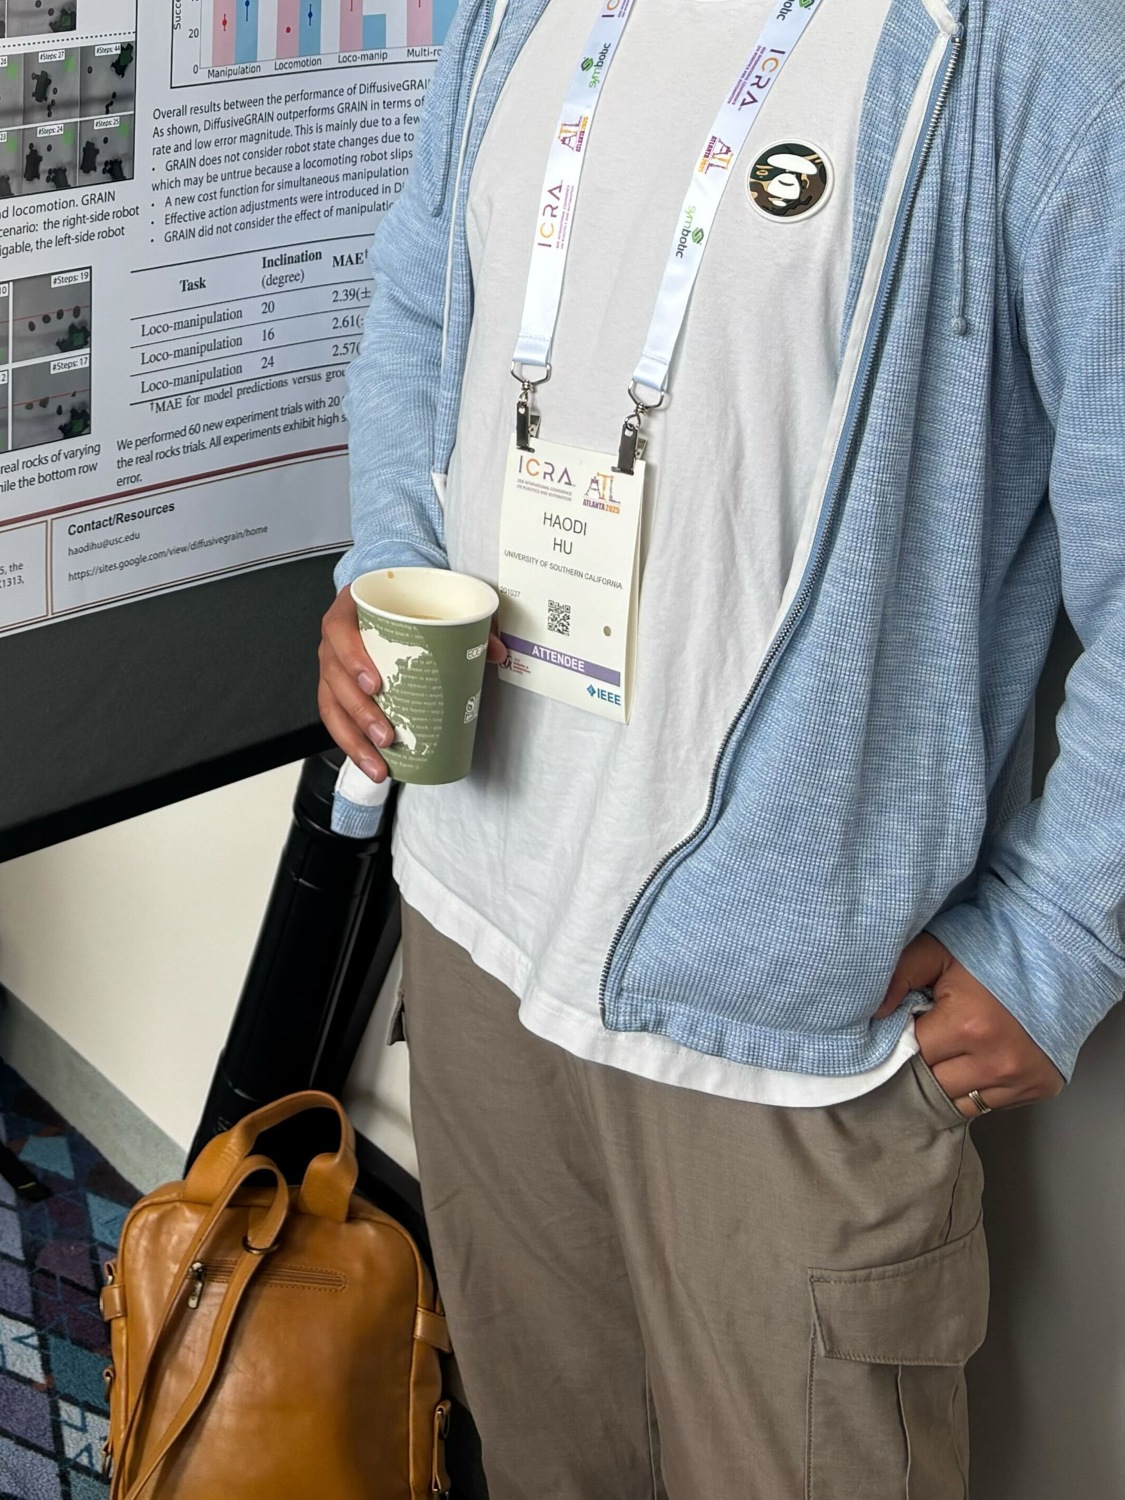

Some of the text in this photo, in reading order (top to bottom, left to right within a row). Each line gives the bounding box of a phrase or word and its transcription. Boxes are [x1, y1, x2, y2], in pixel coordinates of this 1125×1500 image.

[189, 29, 199, 38] 20
[275, 57, 322, 71] Locomotion
[338, 51, 387, 63] Loco-manip
[208, 64, 261, 79] Manipulation
[740, 49, 785, 108] ICRA
[538, 184, 563, 247] ICRA
[676, 205, 696, 258] symbotic
[262, 251, 322, 269] Inclination
[180, 278, 206, 292] Task
[262, 269, 304, 289] (degree)
[261, 301, 275, 315] 20
[141, 309, 243, 337] Loco-manipulation
[262, 328, 275, 342] 16
[141, 336, 243, 365] Loco-manipulation
[261, 356, 274, 369] 24
[141, 364, 243, 393] Loco-manipulation
[518, 455, 572, 486] ICRA
[583, 499, 605, 511] ATLANTA
[68, 503, 175, 536] Contact/Resources
[543, 512, 587, 535] HAODI
[68, 531, 140, 556] haodihu@usc.edu
[68, 525, 268, 581] https://sites.google.com/view/diffusivegrain/home
[553, 538, 572, 555] HU
[504, 550, 622, 589] UNIVERSITY OF SOUTHERN CALIFORNIA
[532, 646, 585, 672] ATTENDEE
[598, 688, 621, 705] IEEE
